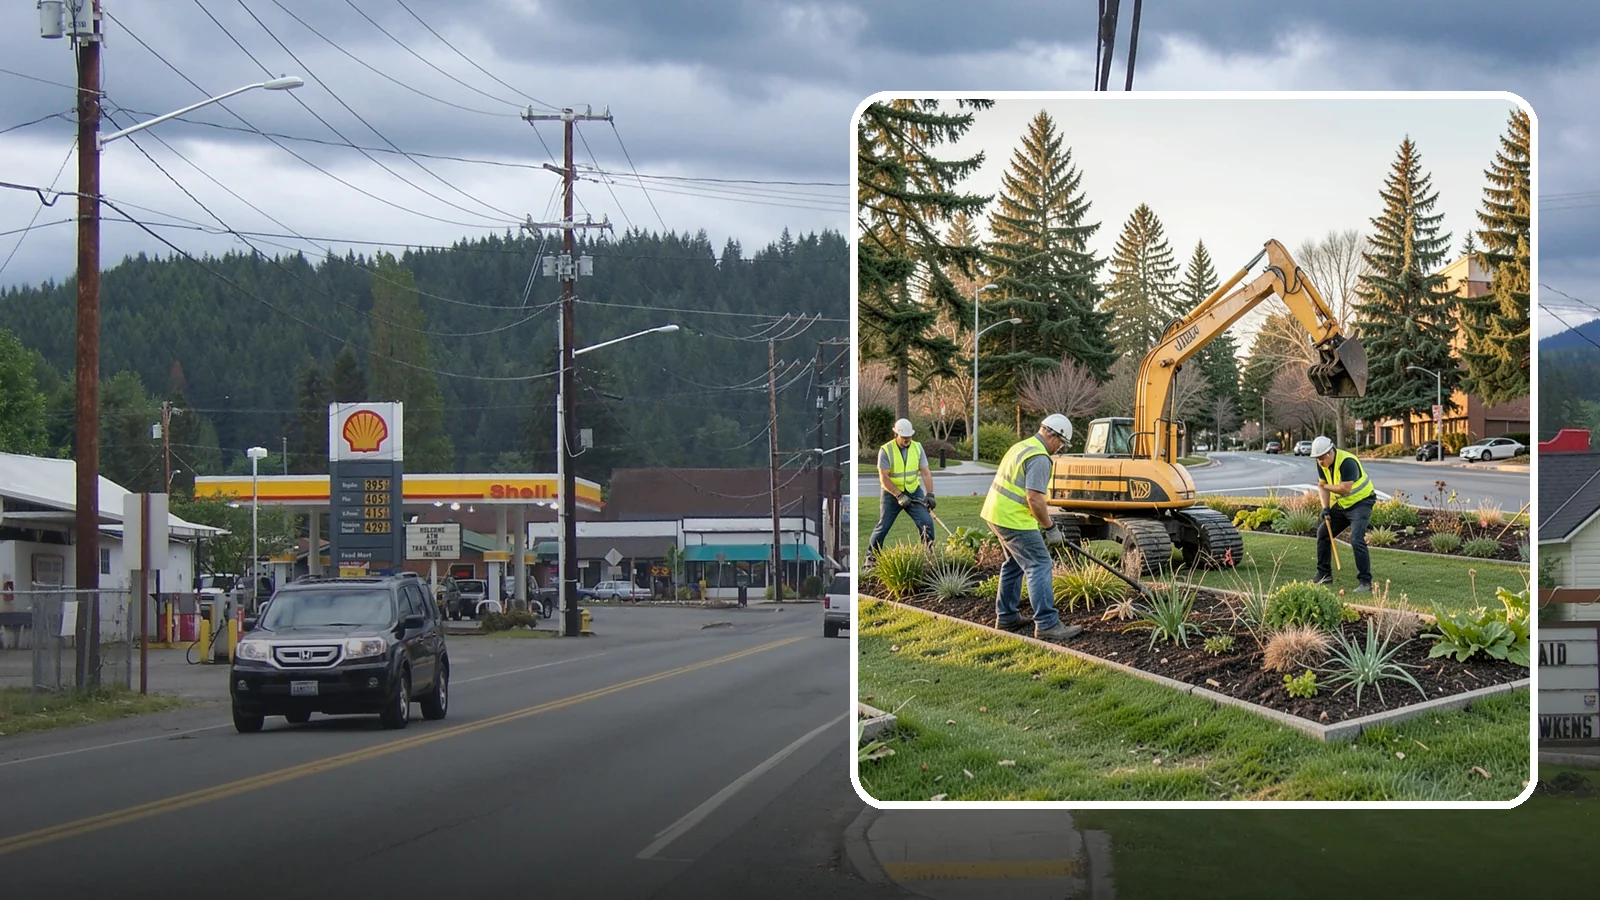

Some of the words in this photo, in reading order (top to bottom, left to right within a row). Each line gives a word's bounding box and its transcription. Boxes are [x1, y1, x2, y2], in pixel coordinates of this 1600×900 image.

[366, 480, 383, 490] 395
[490, 484, 547, 499] Shell
[366, 494, 383, 504] 405
[366, 508, 383, 518] 415
[366, 522, 383, 532] 429
